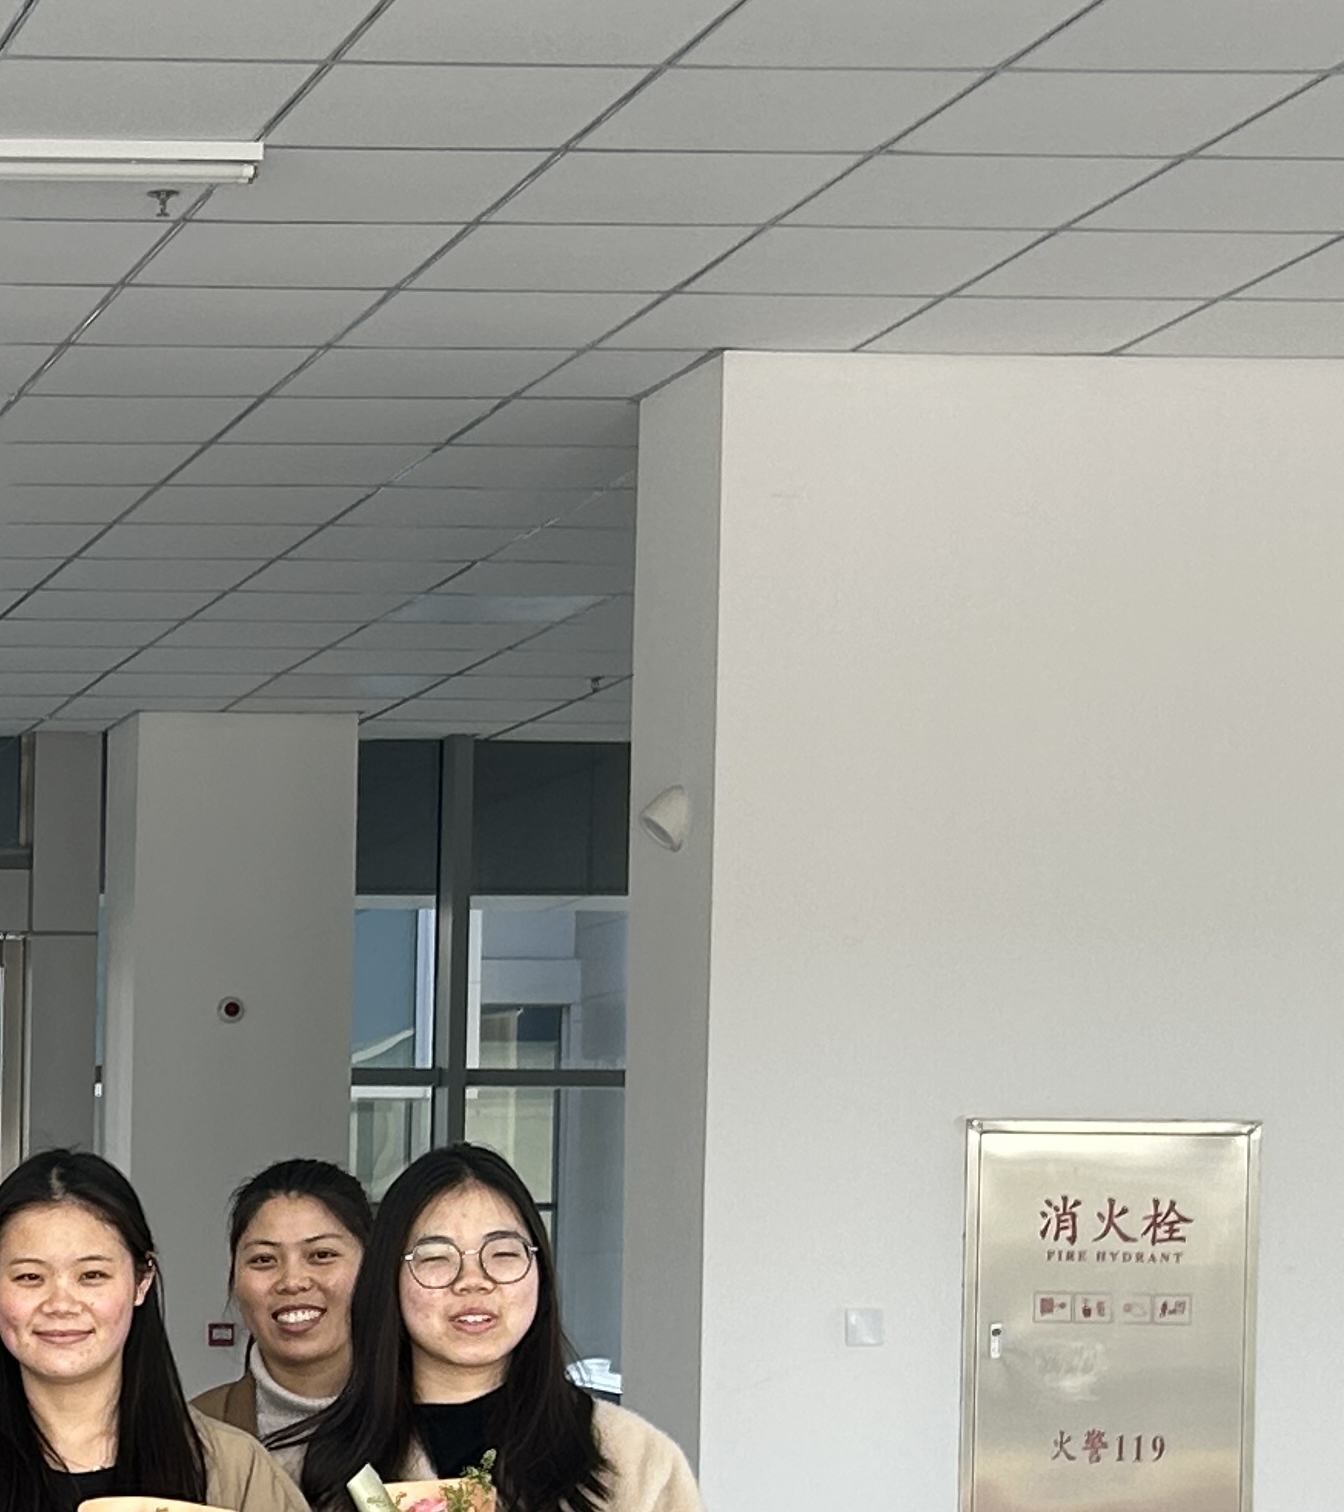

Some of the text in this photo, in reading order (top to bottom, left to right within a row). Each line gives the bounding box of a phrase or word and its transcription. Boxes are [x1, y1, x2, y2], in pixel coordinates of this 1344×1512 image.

[1039, 1196, 1194, 1246] 消火栓
[1046, 1249, 1185, 1264] FIRE HYDRANT
[1050, 1429, 1167, 1464] 火警119
